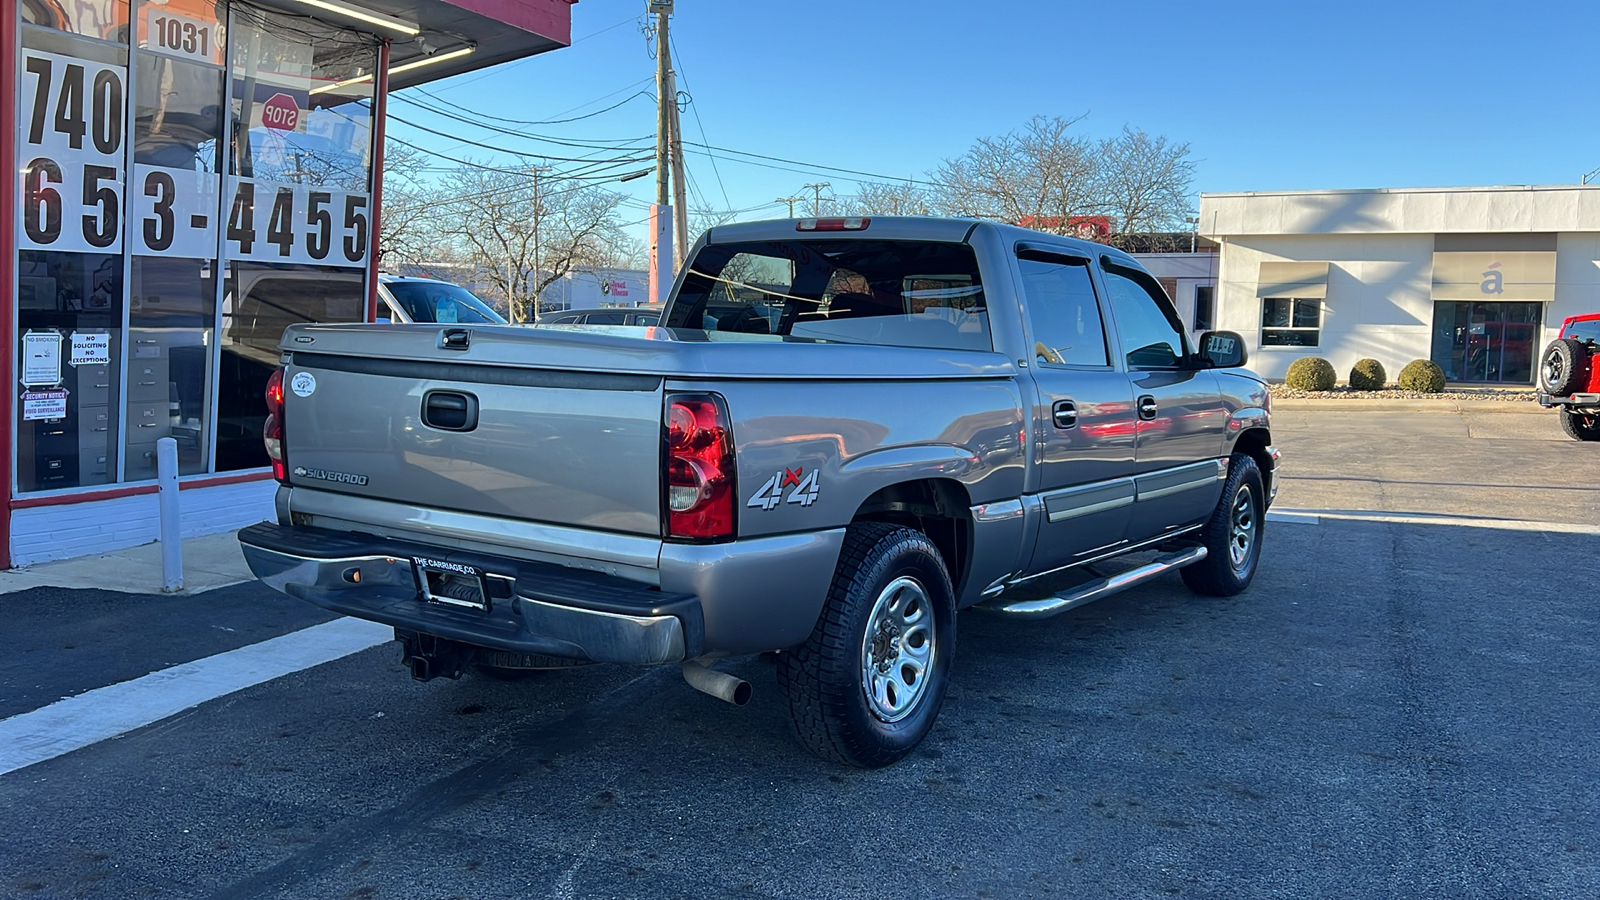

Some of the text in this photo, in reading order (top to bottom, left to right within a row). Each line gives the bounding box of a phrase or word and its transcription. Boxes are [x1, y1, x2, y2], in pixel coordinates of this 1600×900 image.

[155, 16, 208, 56] 1031
[26, 56, 122, 155] 740
[306, 468, 368, 486] SILVERADO
[413, 556, 428, 567] THE
[428, 559, 465, 573] CARRIAGE
